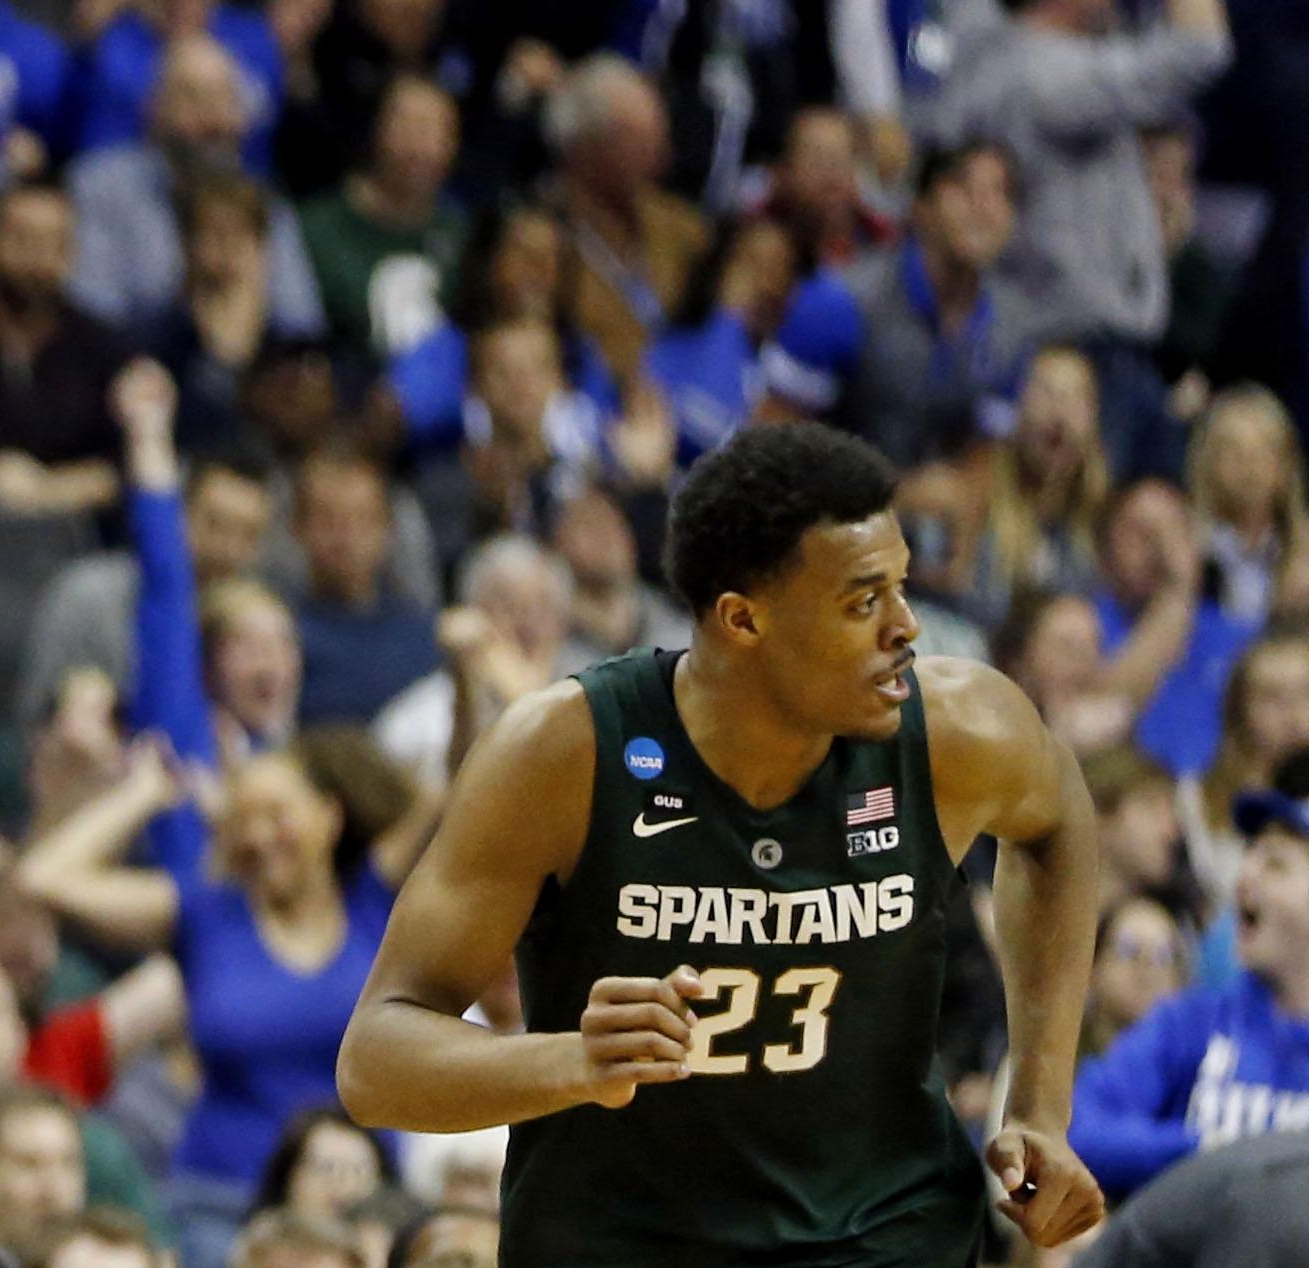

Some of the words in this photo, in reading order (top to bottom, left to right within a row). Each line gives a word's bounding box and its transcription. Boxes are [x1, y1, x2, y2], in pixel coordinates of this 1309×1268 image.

[654, 794, 683, 809] GUS
[616, 873, 915, 945] SPARTANS
[688, 966, 843, 1075] 23
